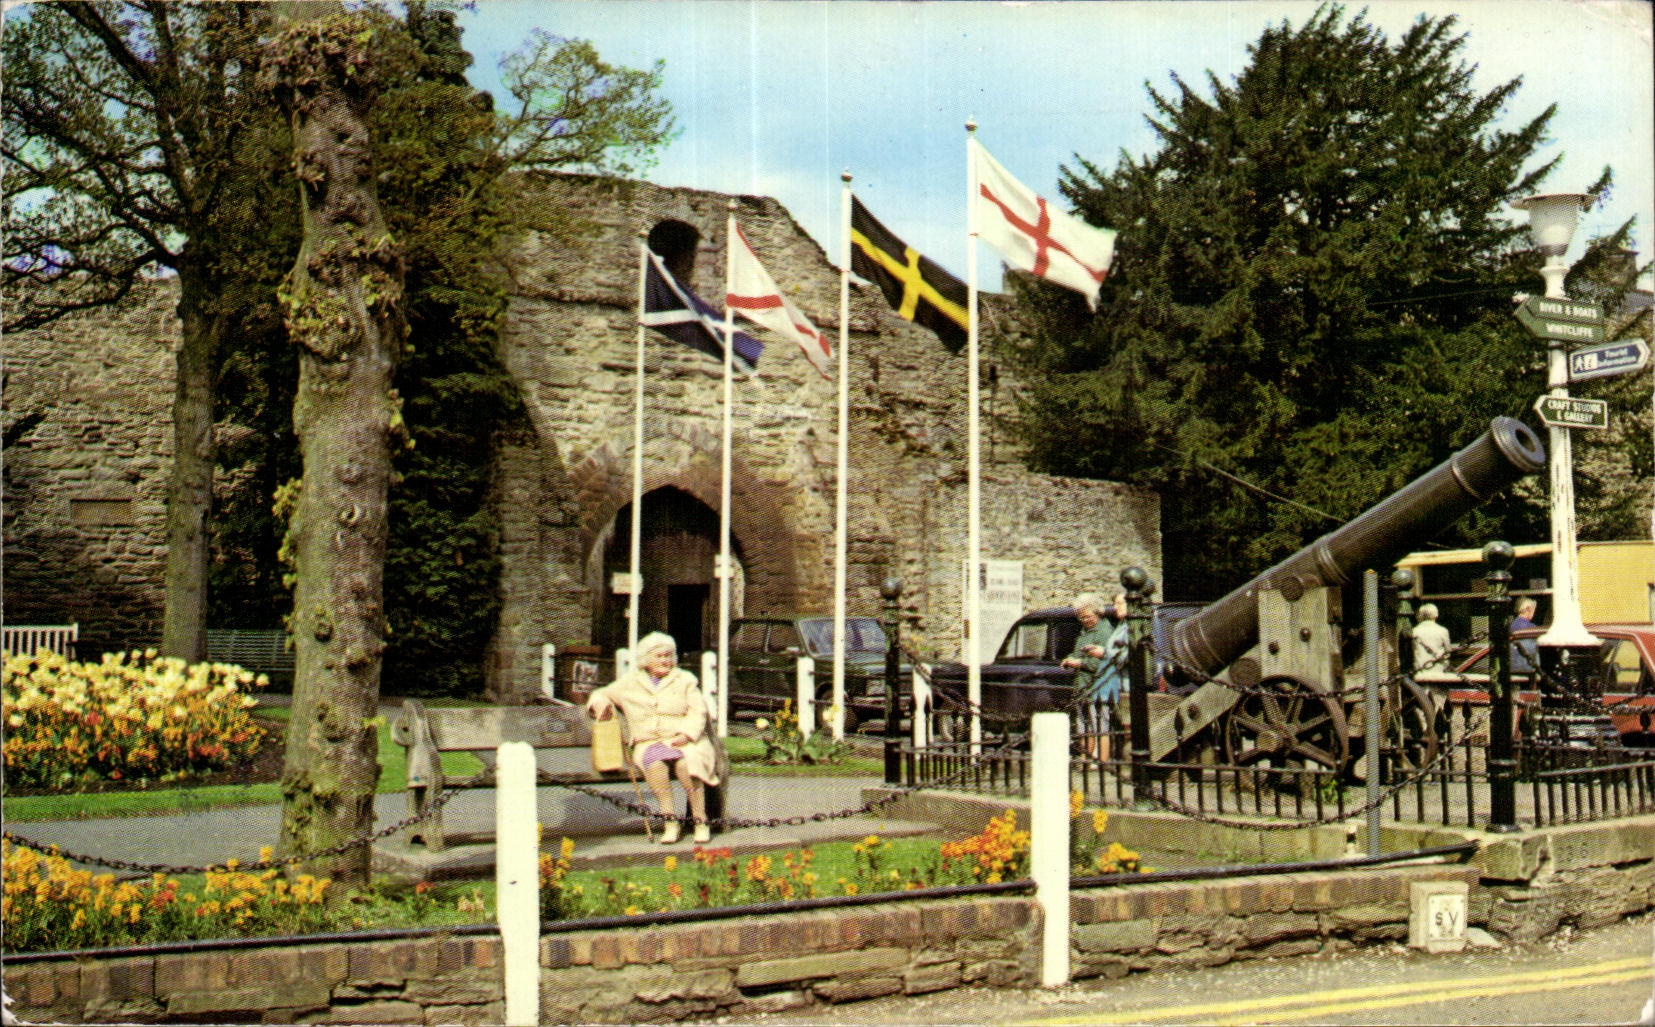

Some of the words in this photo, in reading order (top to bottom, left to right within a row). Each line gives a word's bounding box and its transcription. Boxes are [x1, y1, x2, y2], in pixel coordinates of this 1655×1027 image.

[1540, 302, 1562, 314] RIVER
[1565, 305, 1571, 316] &
[1573, 306, 1597, 319] BOATS
[1547, 400, 1570, 411] CRAFT
[1557, 410, 1562, 420] &
[1564, 411, 1594, 424] GALLERY
